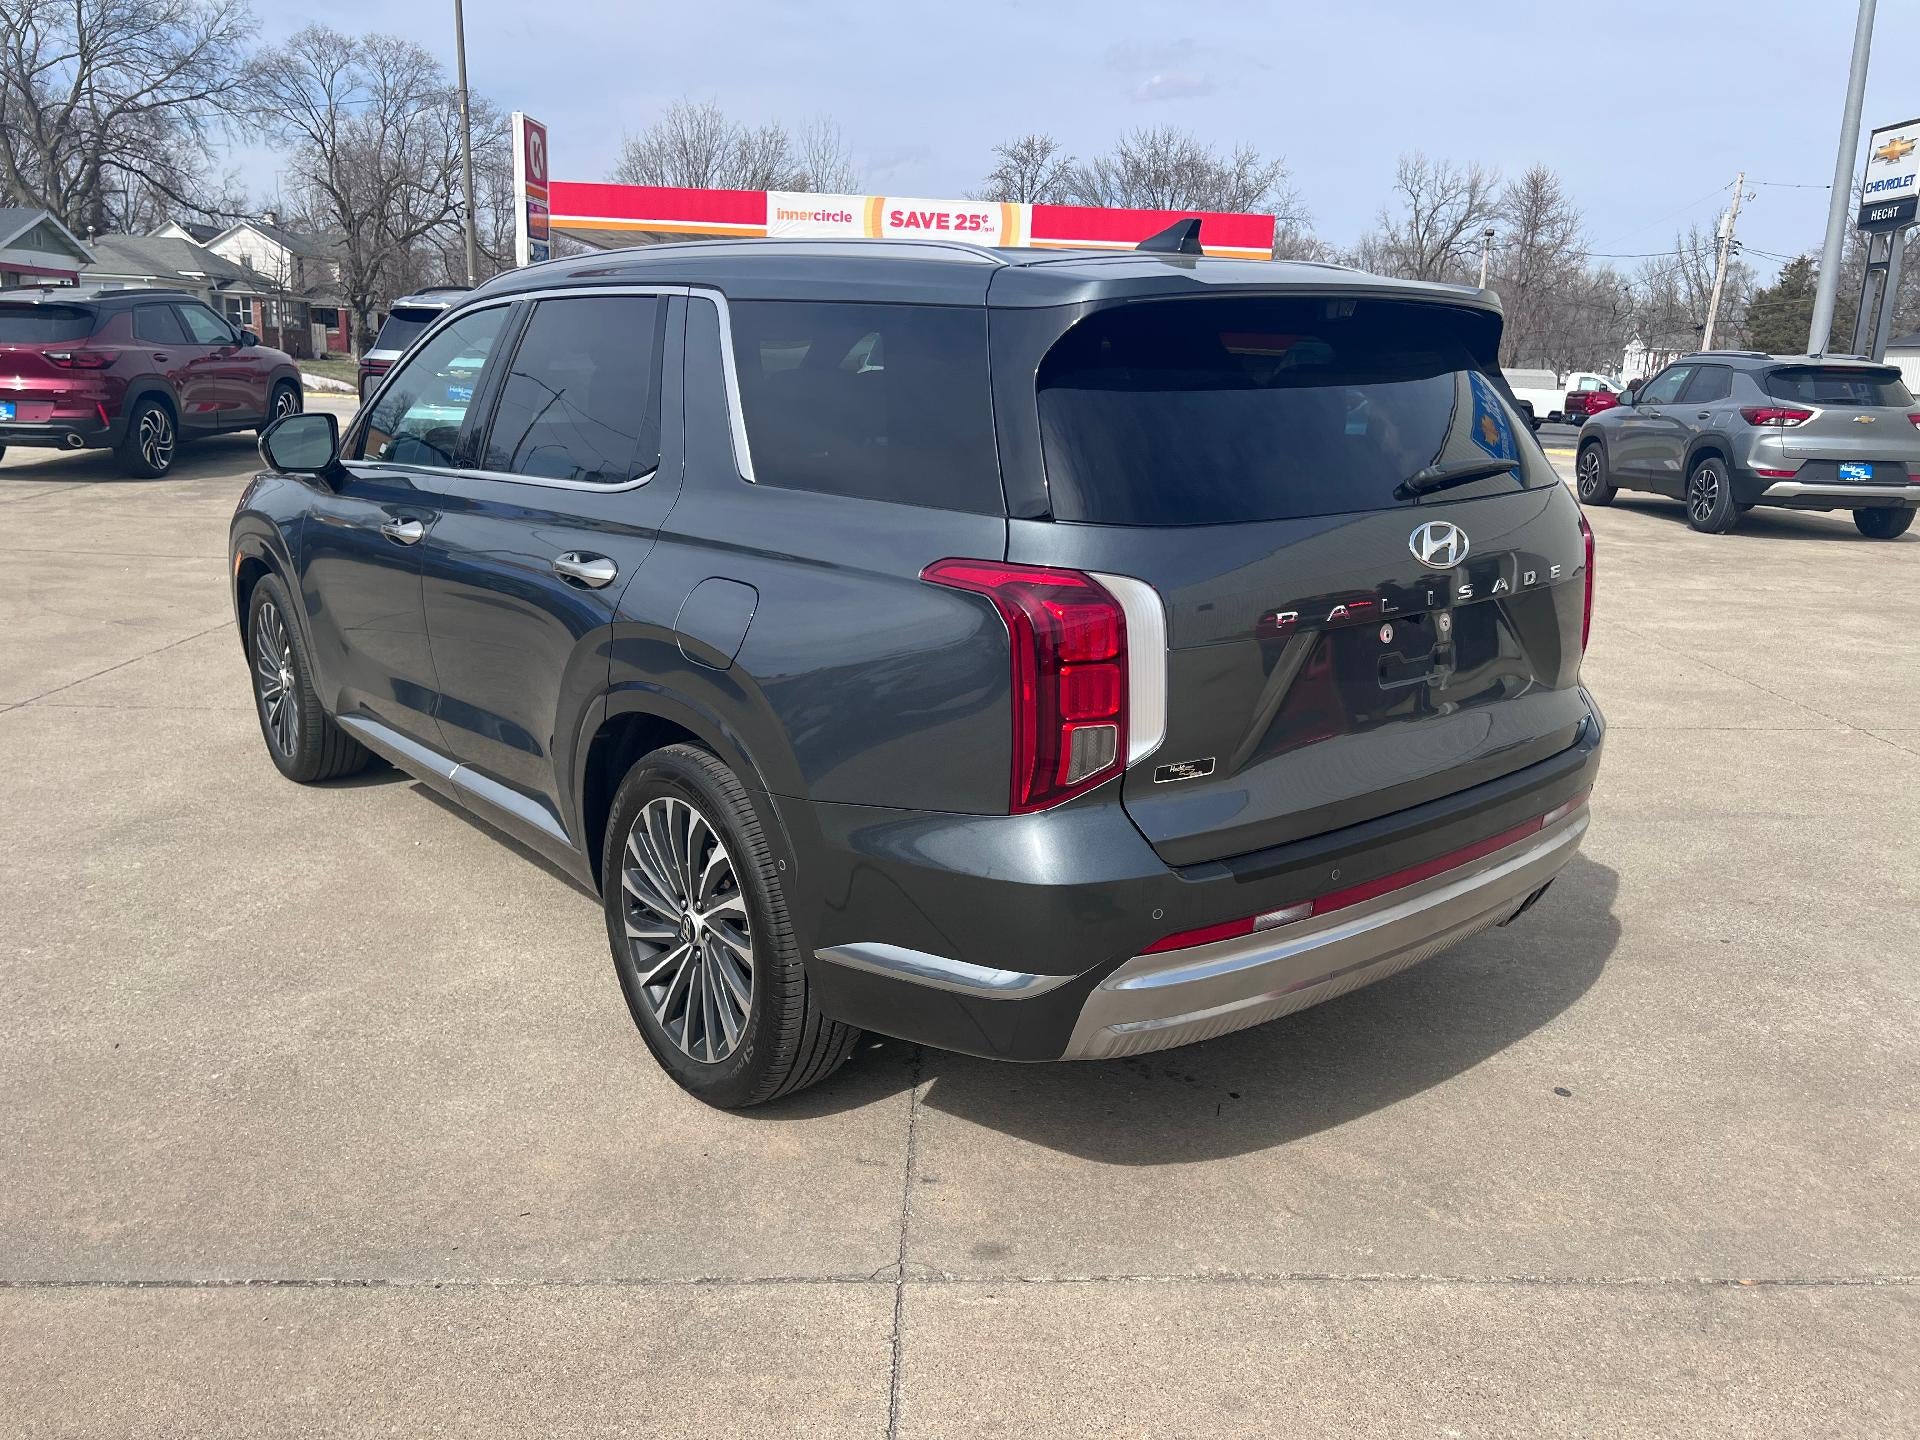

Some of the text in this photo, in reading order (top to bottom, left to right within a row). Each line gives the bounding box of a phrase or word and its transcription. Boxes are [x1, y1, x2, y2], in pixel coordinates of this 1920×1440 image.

[1865, 174, 1916, 194] CHEVROLET
[776, 208, 852, 223] innercircle
[889, 210, 950, 230] SAVE
[1871, 206, 1899, 221] HECHT
[1275, 564, 1562, 629] PALISADE
